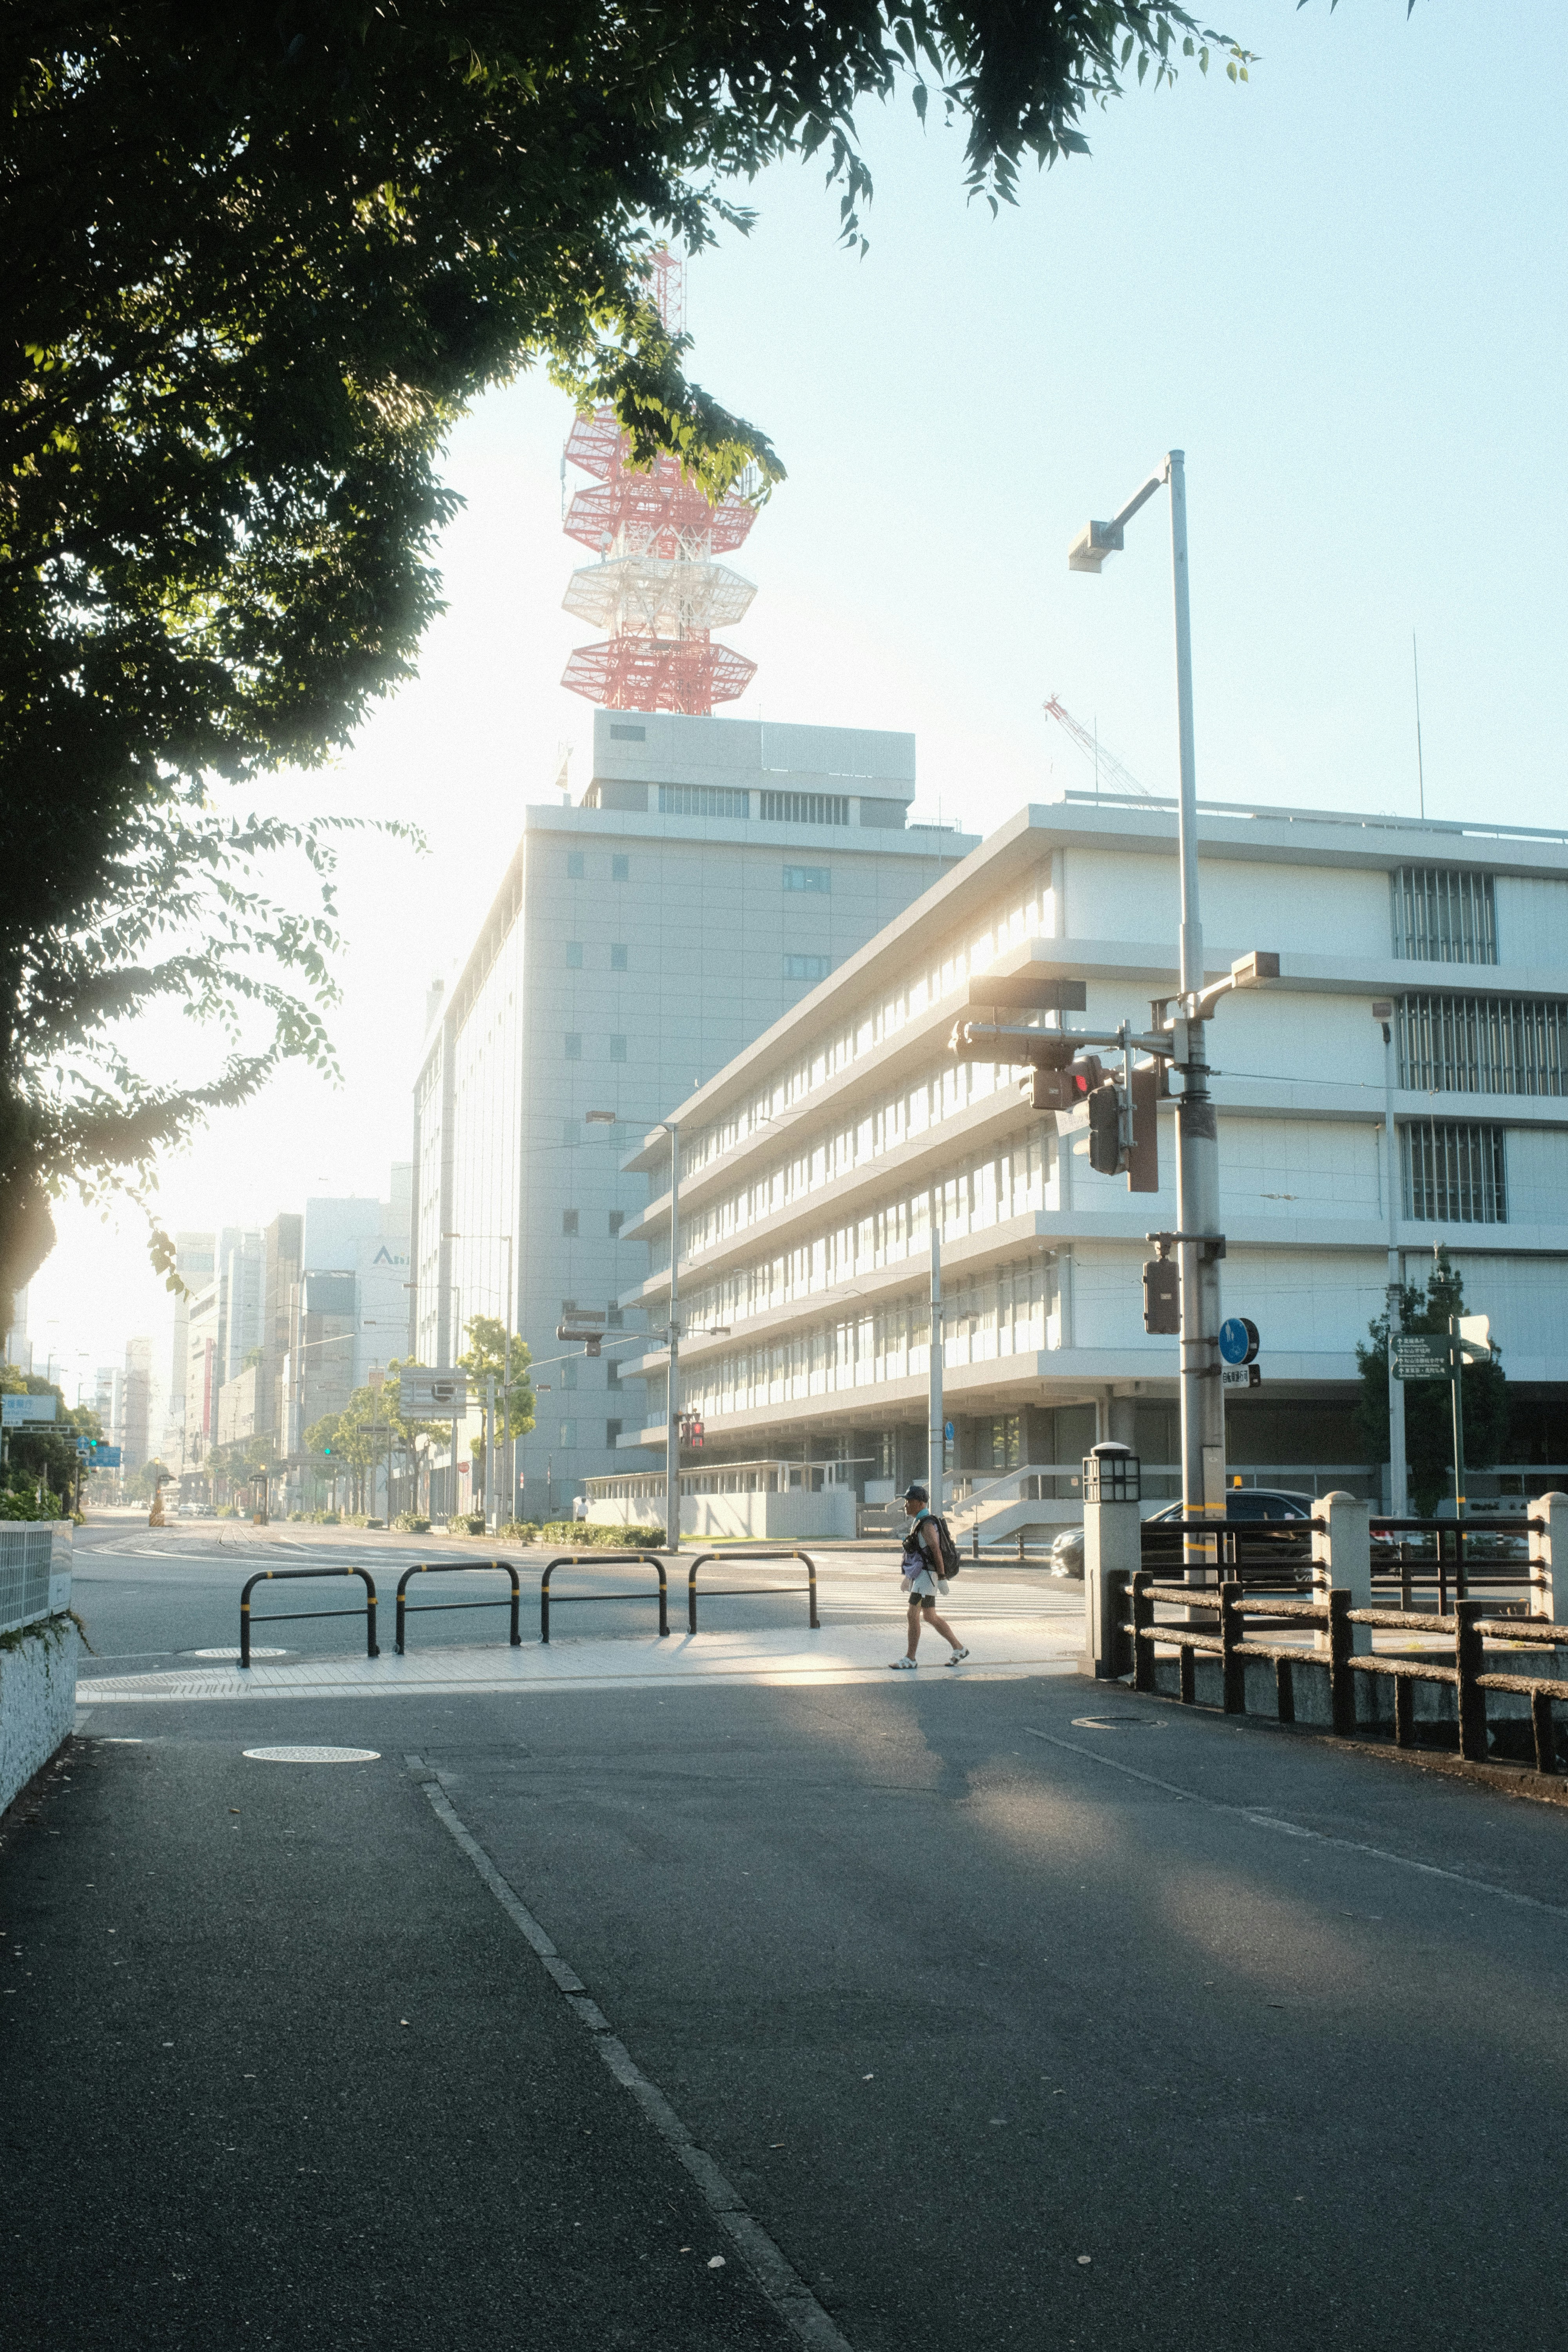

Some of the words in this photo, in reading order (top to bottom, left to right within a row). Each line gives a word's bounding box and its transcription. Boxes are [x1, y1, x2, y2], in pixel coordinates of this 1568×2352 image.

[1223, 1370, 1248, 1383] 自転車通行可
